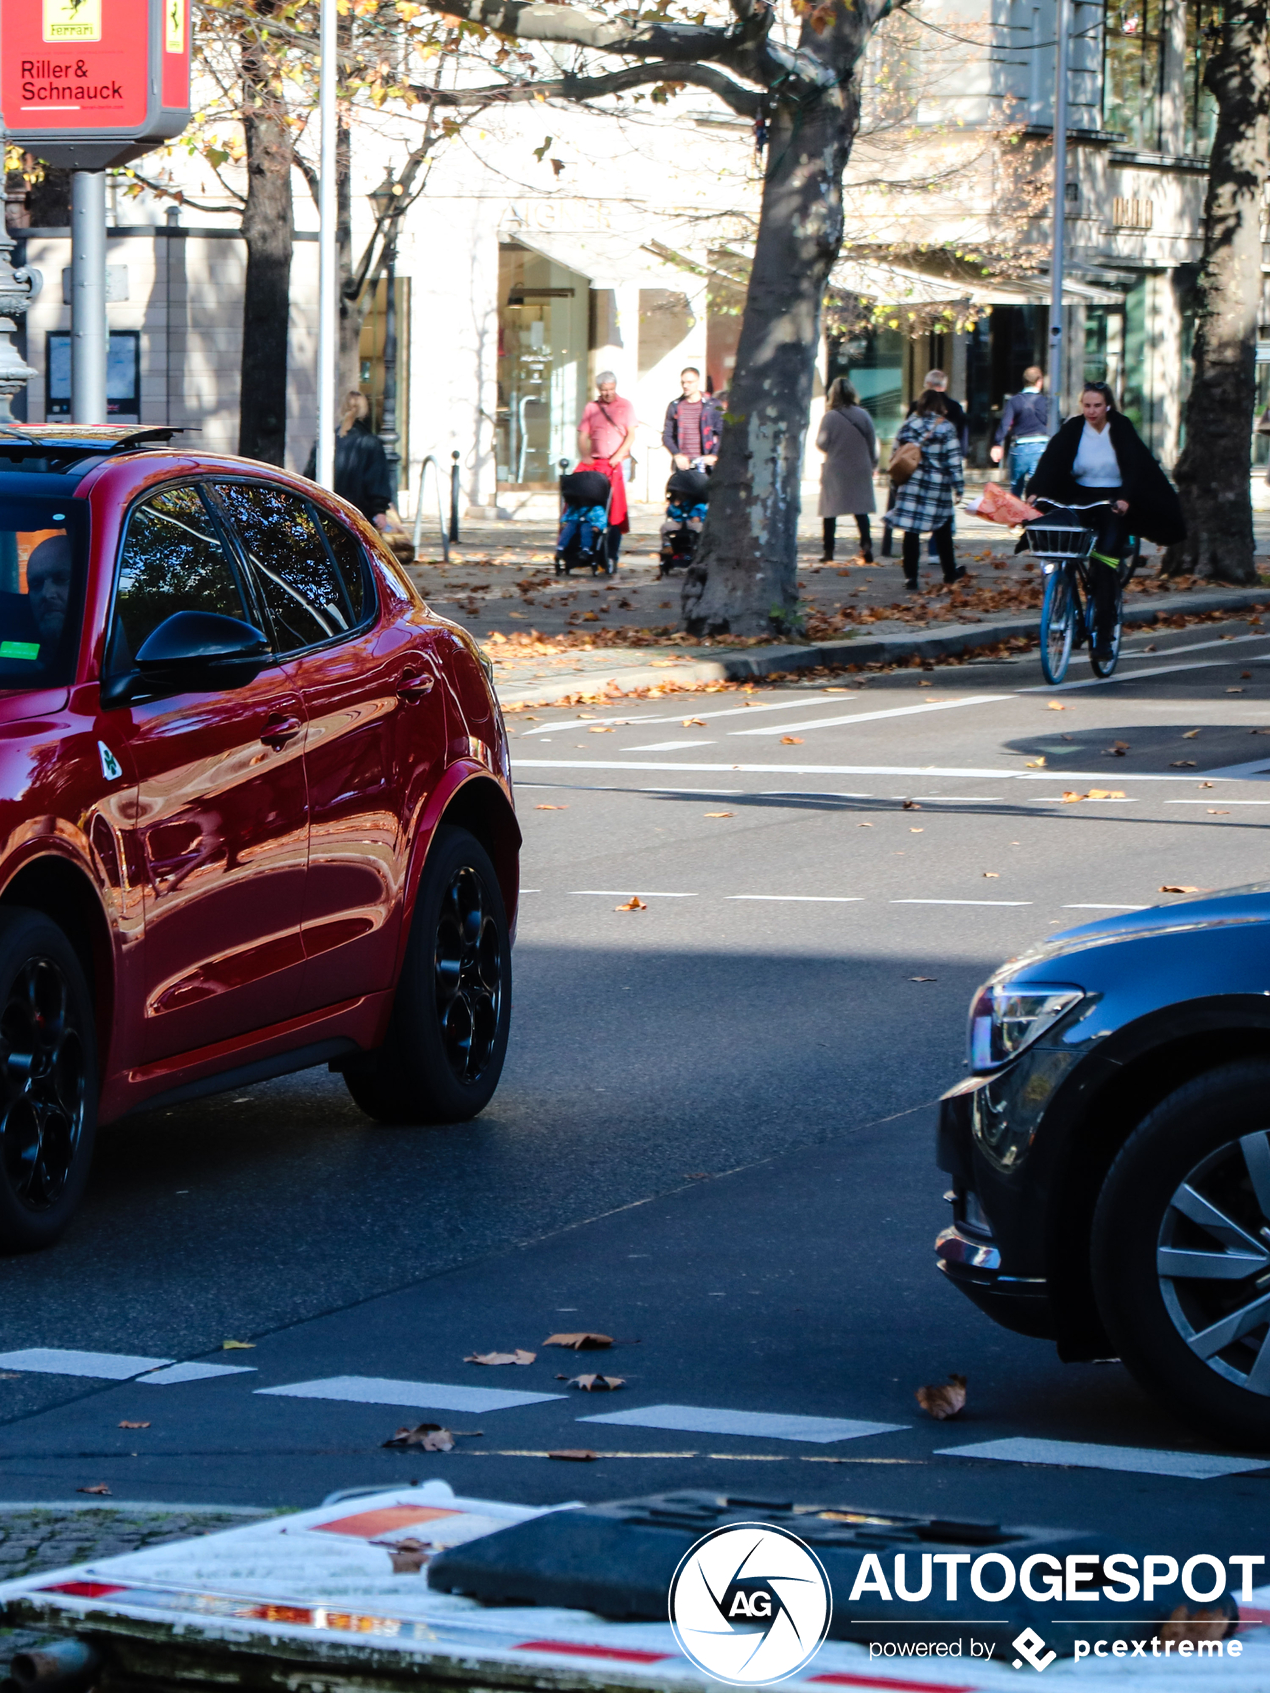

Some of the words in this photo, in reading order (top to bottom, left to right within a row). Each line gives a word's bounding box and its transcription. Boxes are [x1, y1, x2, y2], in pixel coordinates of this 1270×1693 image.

[50, 24, 94, 36] Ferrari
[21, 60, 72, 79] Riller
[74, 59, 89, 78] &
[22, 80, 123, 100] Schnauck
[496, 200, 612, 229] AIGNER
